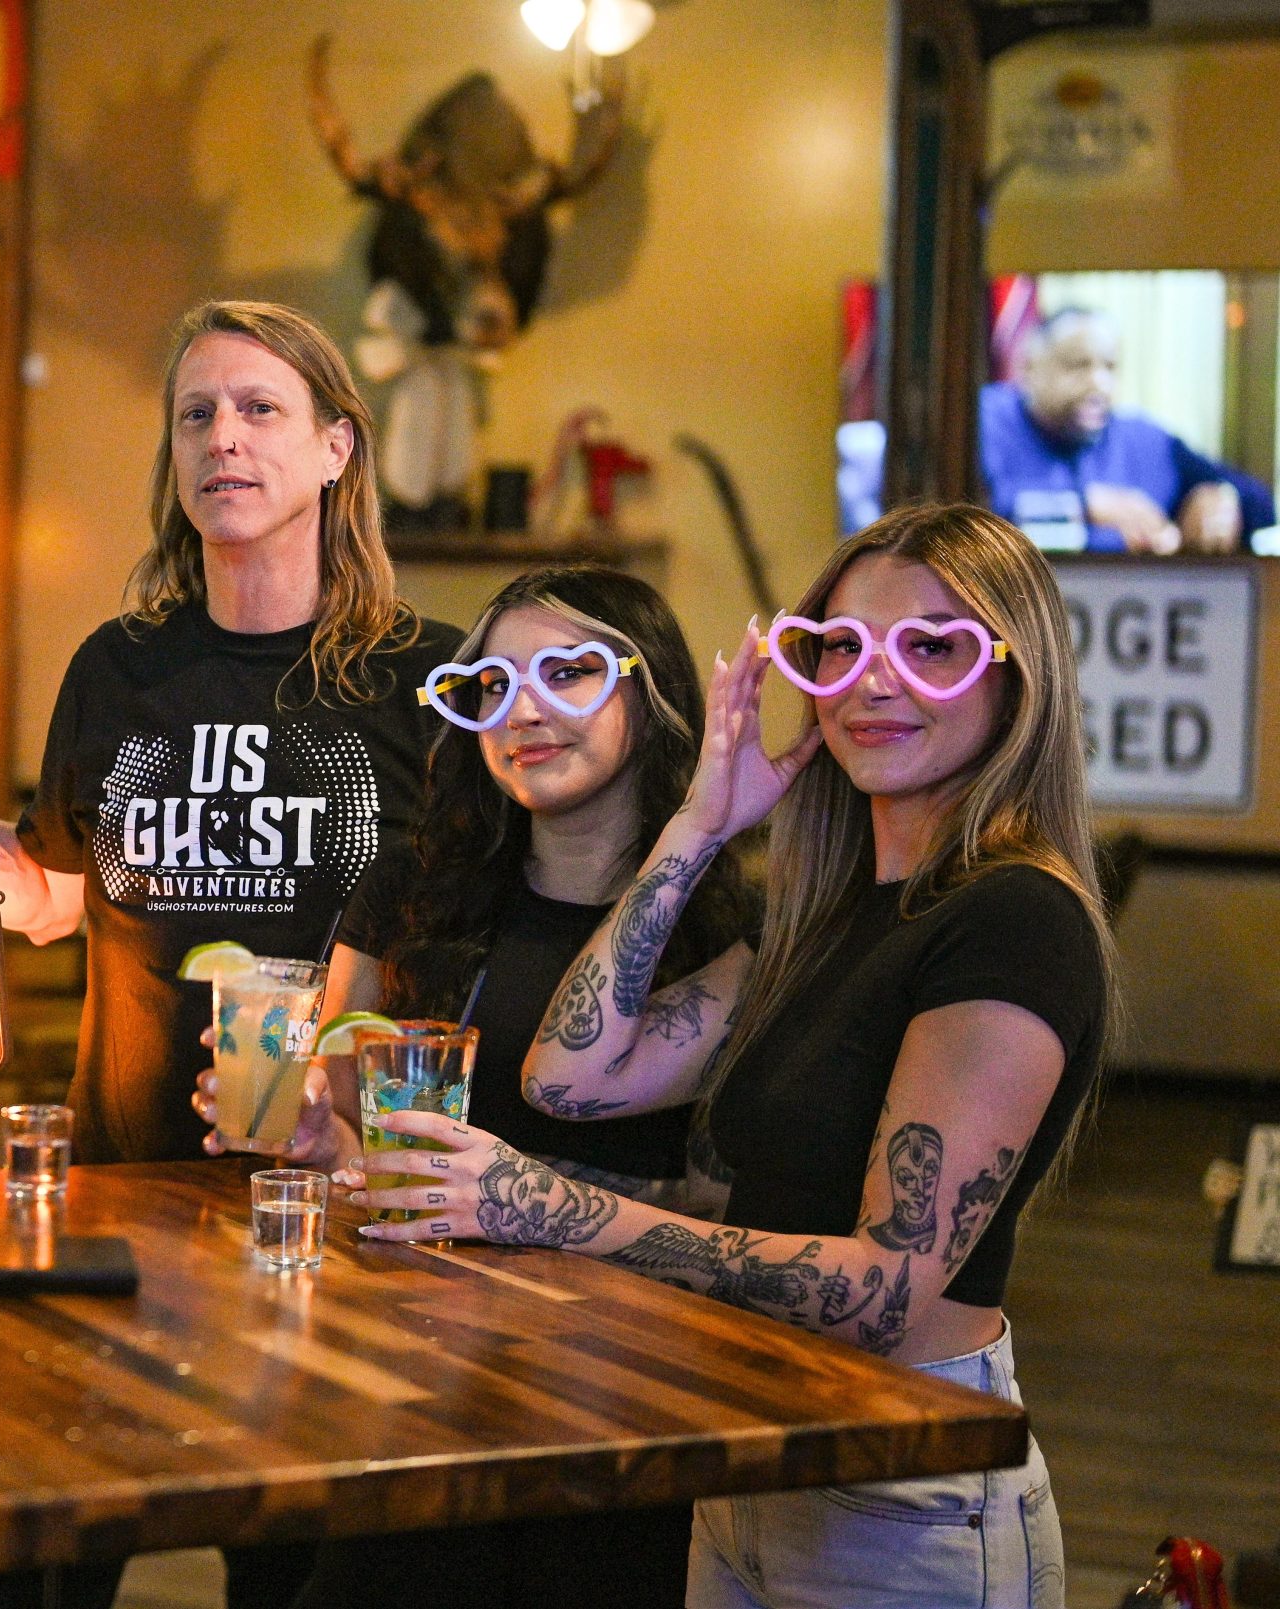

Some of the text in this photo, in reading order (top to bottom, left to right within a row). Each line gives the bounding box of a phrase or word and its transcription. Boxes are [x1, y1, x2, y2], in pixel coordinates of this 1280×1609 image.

[190, 724, 269, 793] US
[123, 797, 326, 867] GHOST
[146, 901, 294, 913] USGHOSTADVENTURES.COM
[148, 876, 295, 898] ADVENTURES
